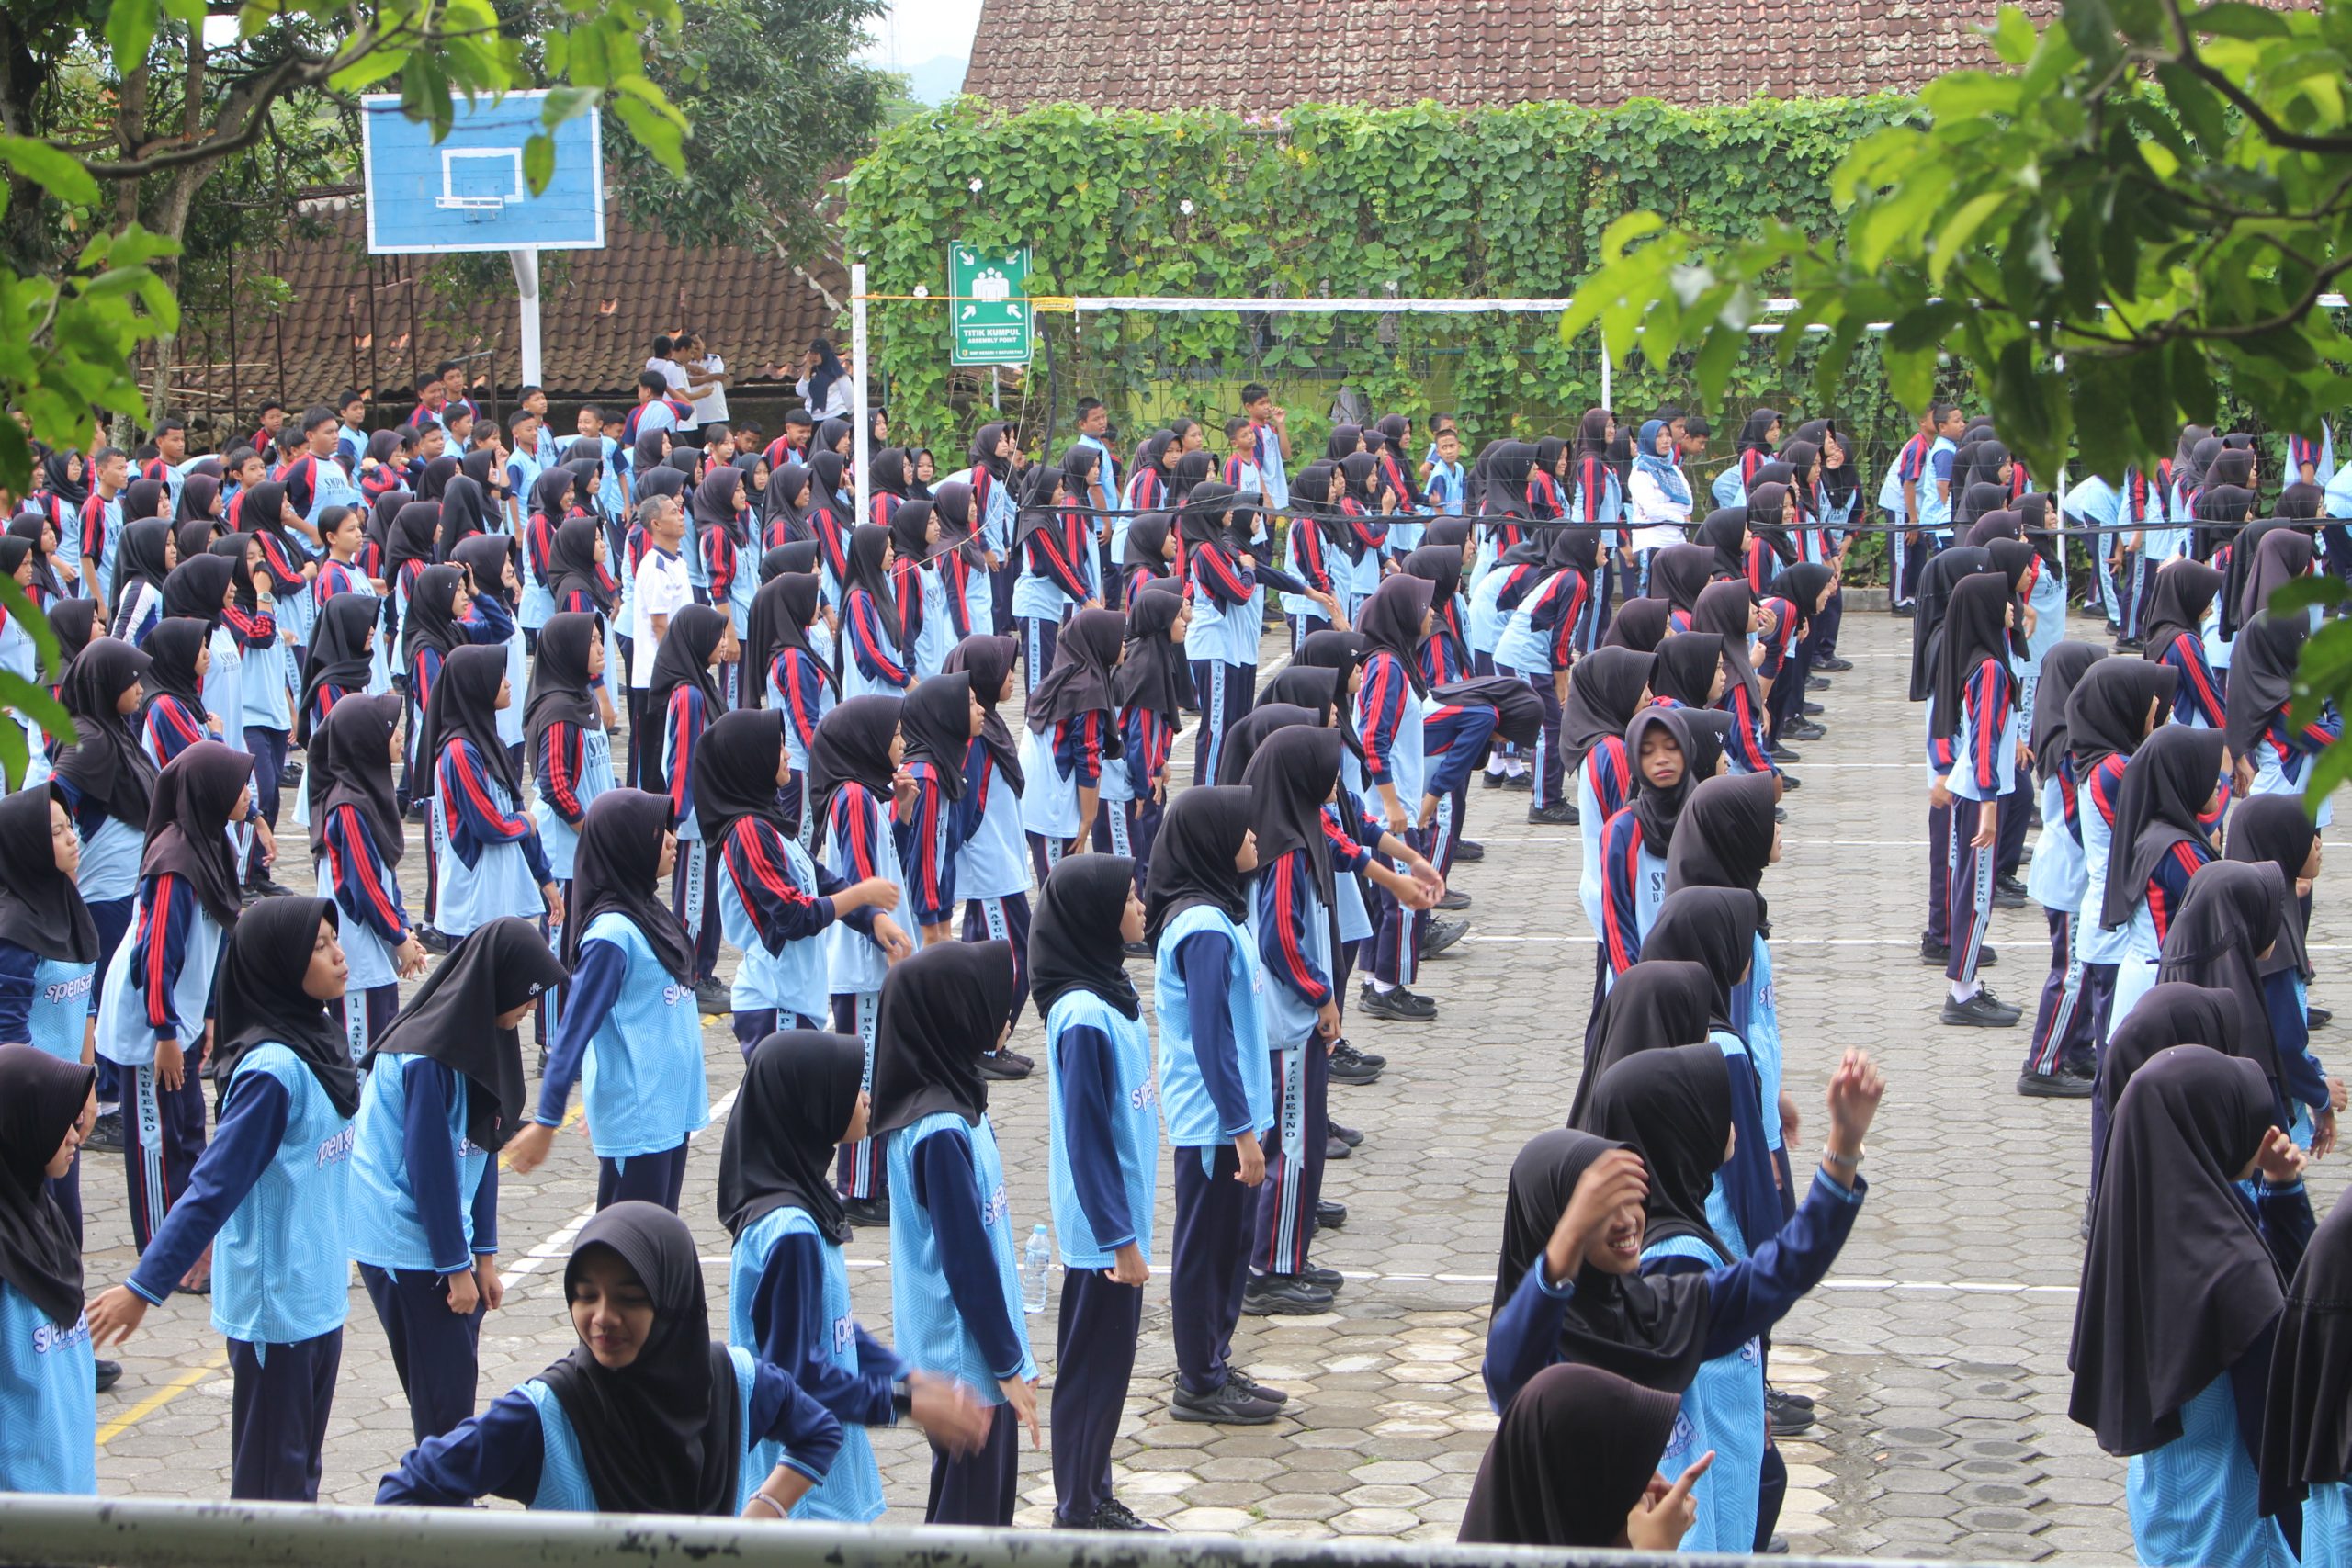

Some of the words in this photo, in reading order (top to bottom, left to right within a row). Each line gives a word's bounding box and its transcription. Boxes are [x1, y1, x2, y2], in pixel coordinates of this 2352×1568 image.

[963, 329, 985, 337] TITIK
[987, 328, 1021, 336] KUMPUL
[1114, 811, 1125, 856] BATURETN
[689, 854, 700, 911] BATURETNO
[1977, 849, 1986, 904] ATURETNO
[353, 998, 359, 1009] 1
[865, 998, 872, 1009] 1
[140, 1065, 155, 1132] ATURETNO
